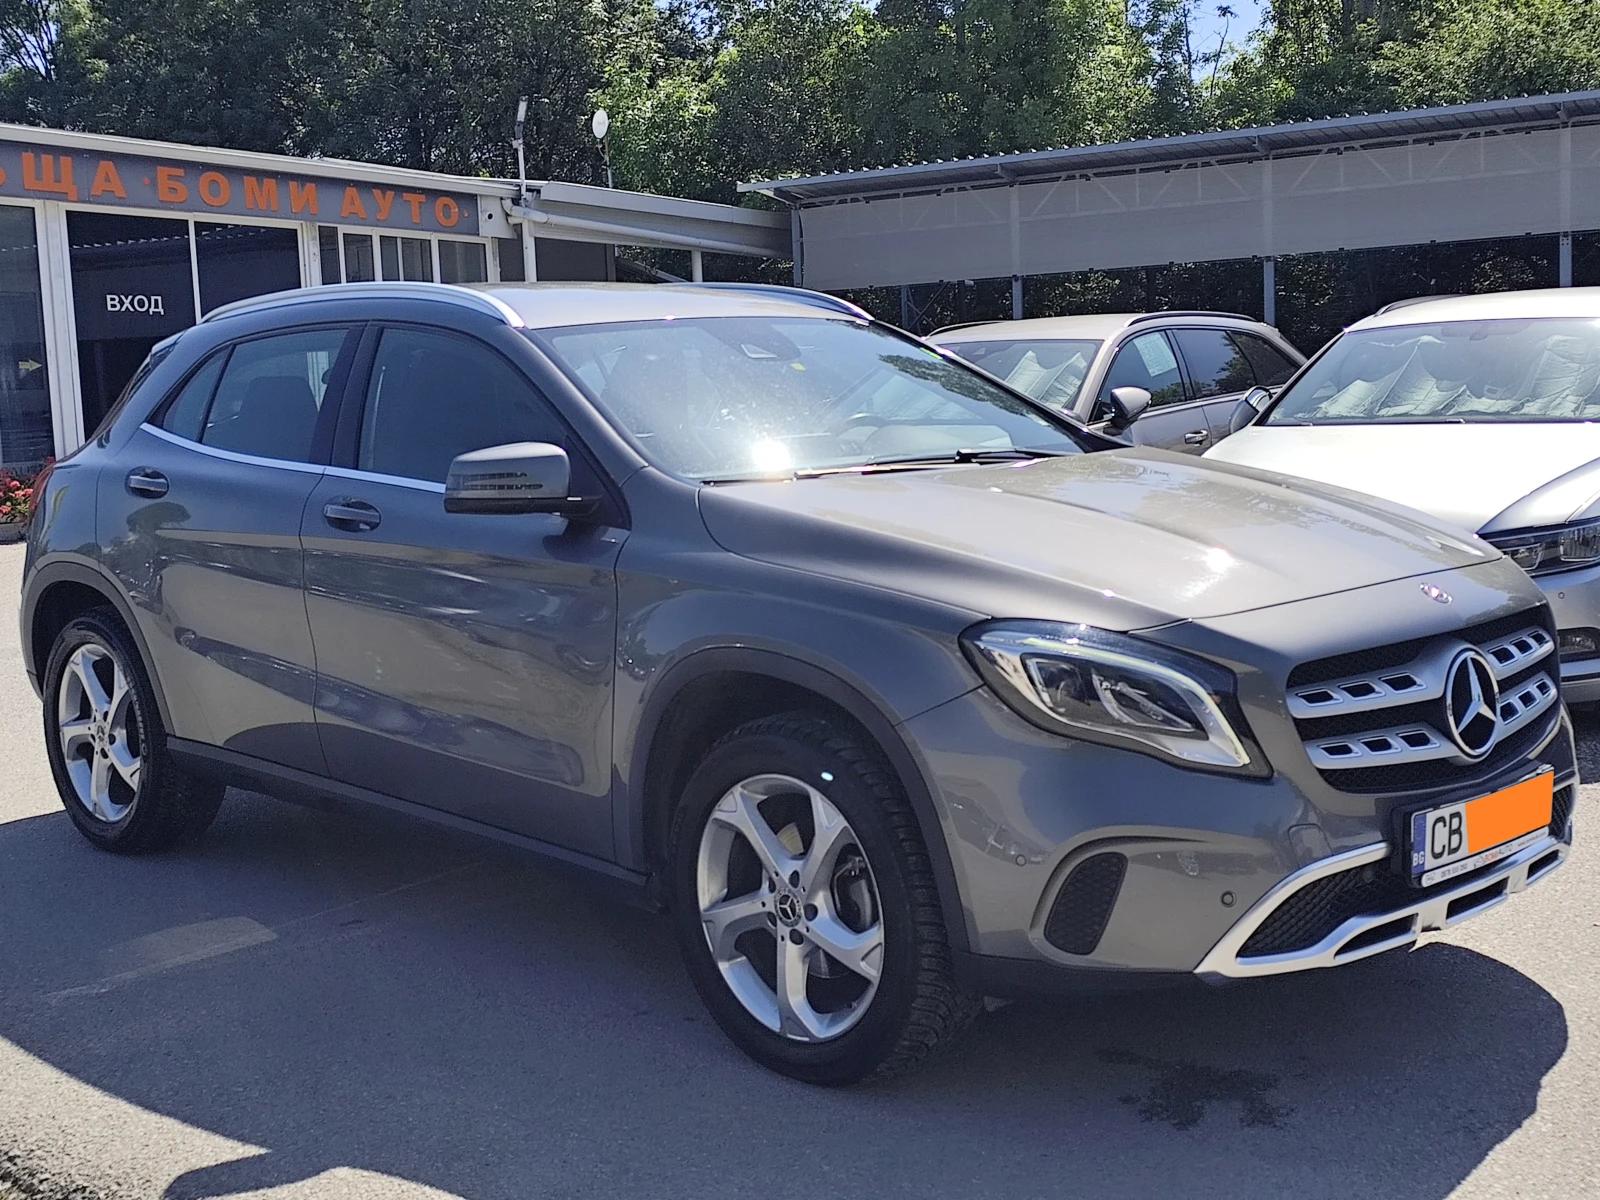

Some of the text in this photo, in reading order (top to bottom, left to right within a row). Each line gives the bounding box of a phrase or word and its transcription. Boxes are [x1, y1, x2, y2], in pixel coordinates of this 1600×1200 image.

[0, 152, 127, 202] ЩА
[340, 186, 459, 227] АУТО
[106, 294, 164, 315] ВХОД
[1412, 851, 1425, 867] BG
